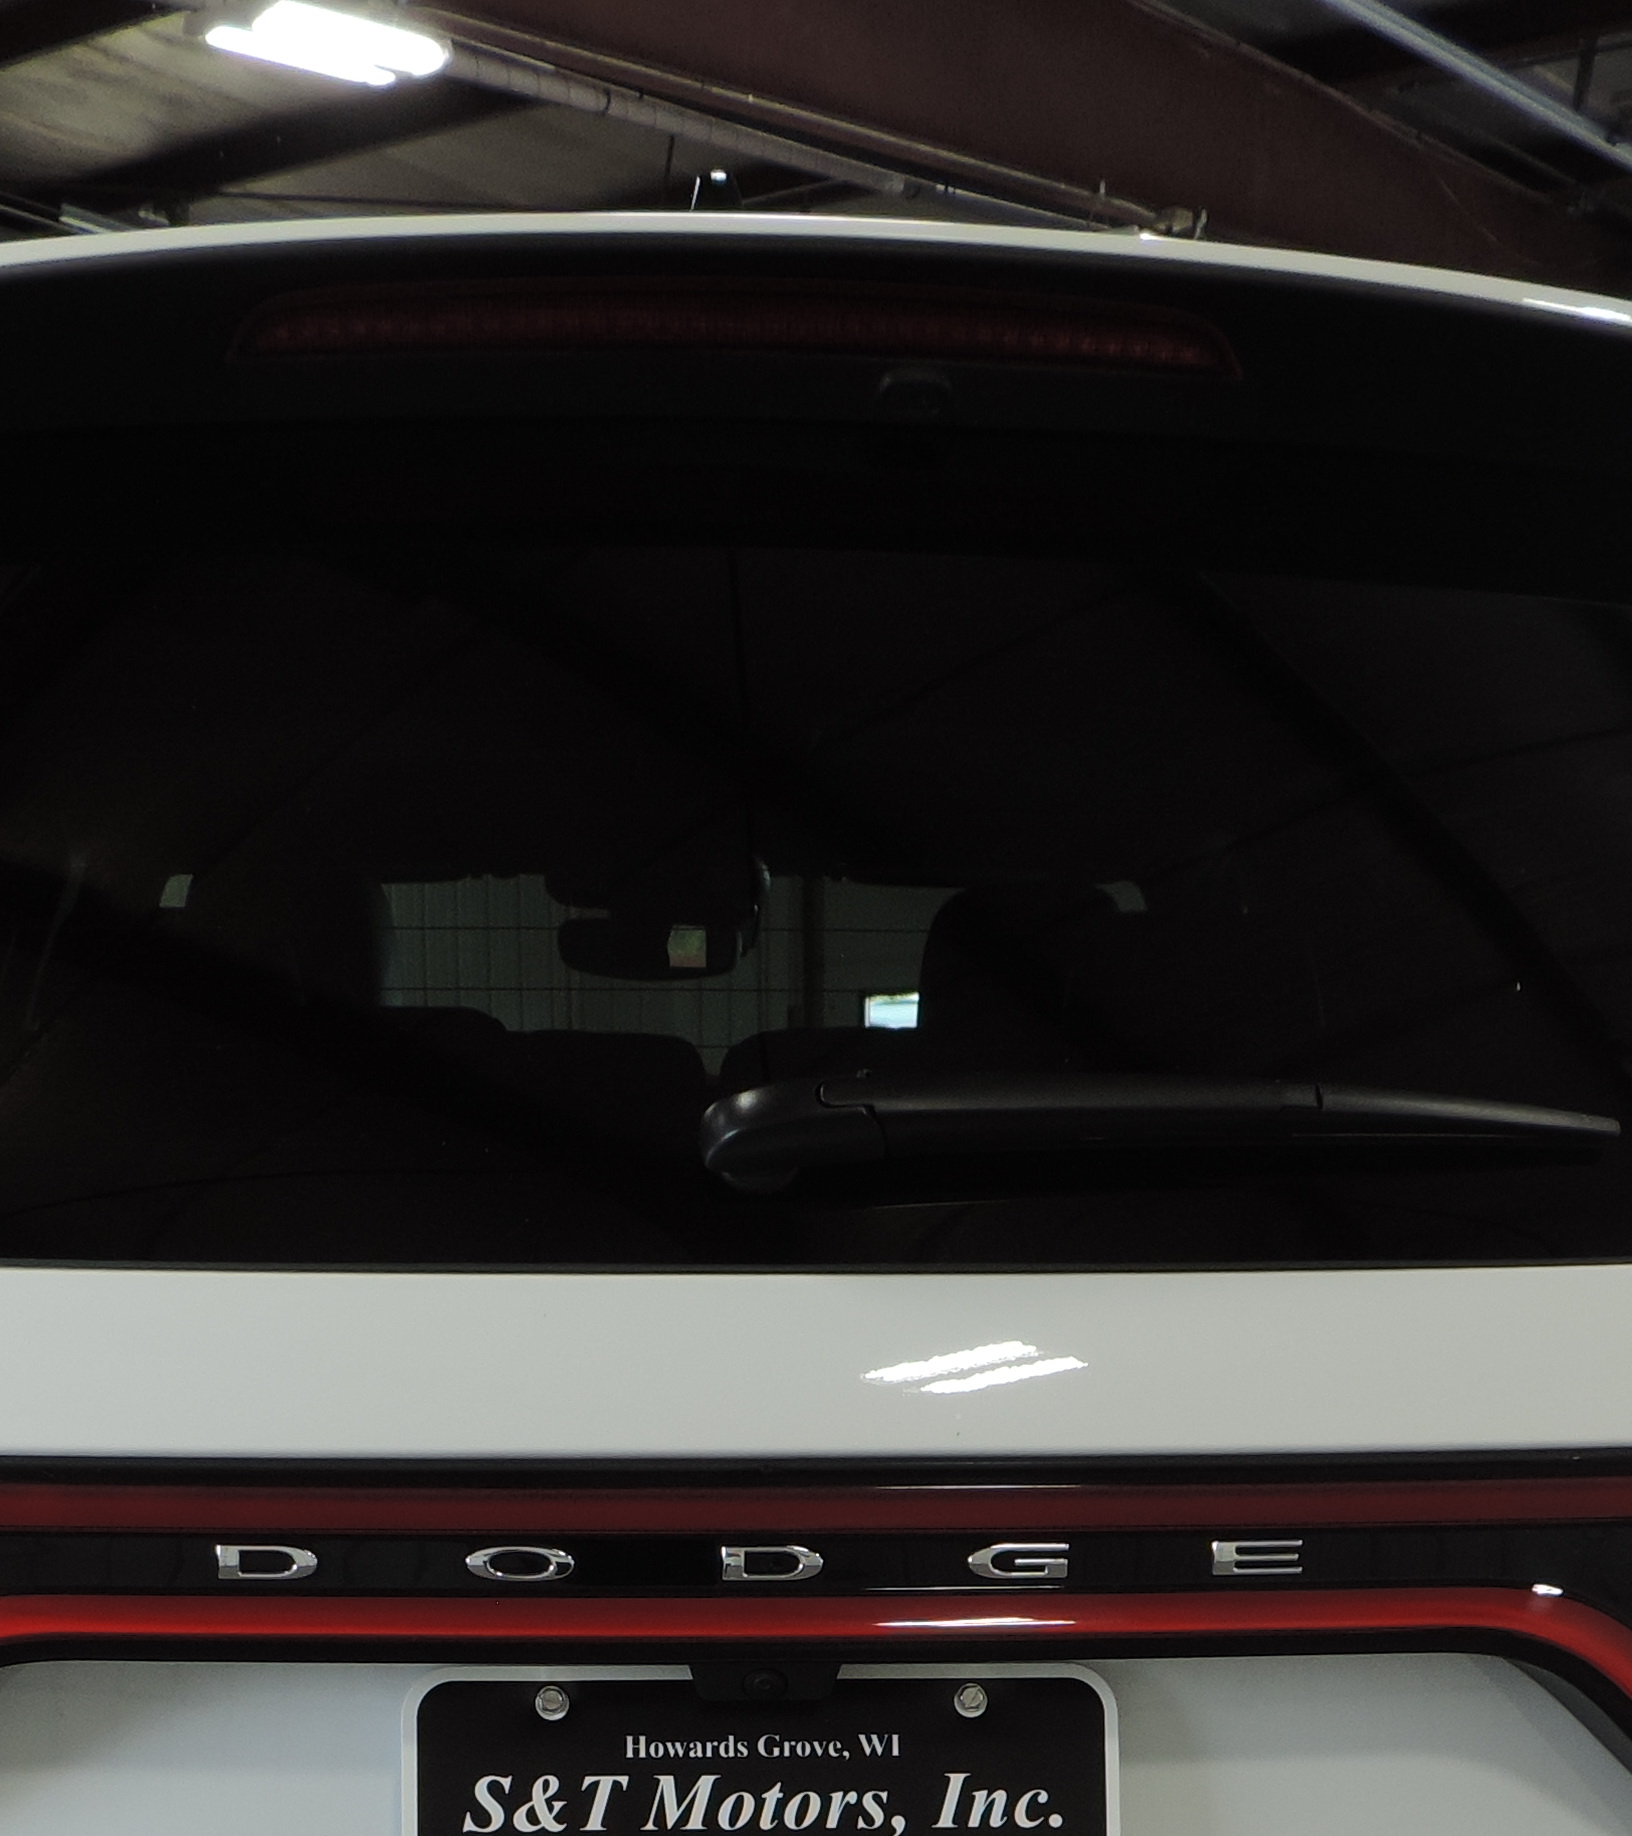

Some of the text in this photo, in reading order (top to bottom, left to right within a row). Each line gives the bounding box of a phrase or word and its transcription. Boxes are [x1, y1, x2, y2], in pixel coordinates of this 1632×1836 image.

[214, 1536, 1305, 1584] DODGE
[624, 1733, 901, 1760] Howards Grove, WI
[462, 1774, 629, 1833] S&T
[931, 1772, 1064, 1830] Inc.
